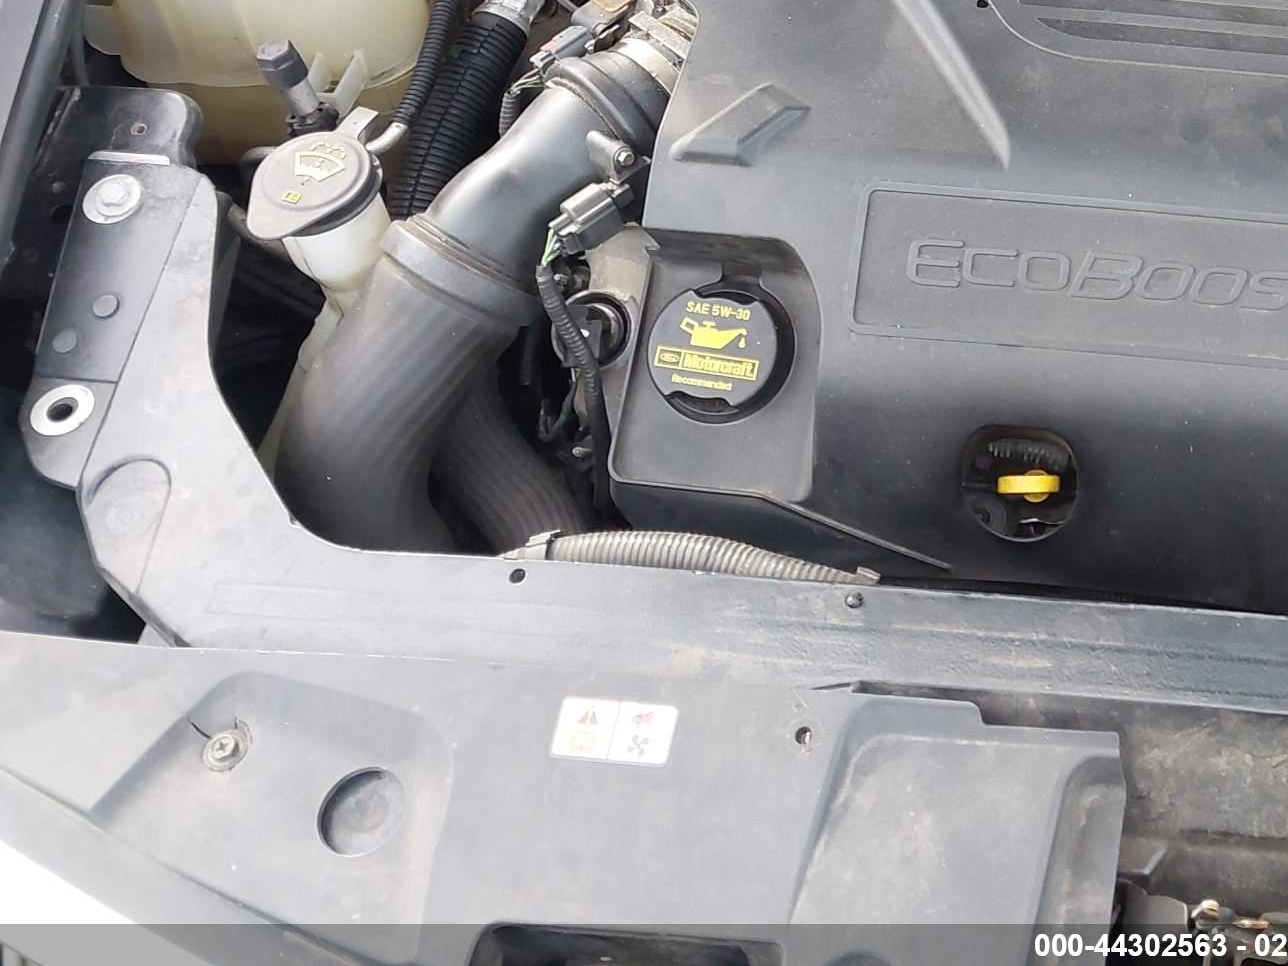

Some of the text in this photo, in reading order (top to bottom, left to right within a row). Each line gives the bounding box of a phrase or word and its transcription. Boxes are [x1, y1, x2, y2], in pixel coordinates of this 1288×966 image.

[686, 301, 751, 321] SAE 5W-30
[671, 373, 733, 391] Recommended
